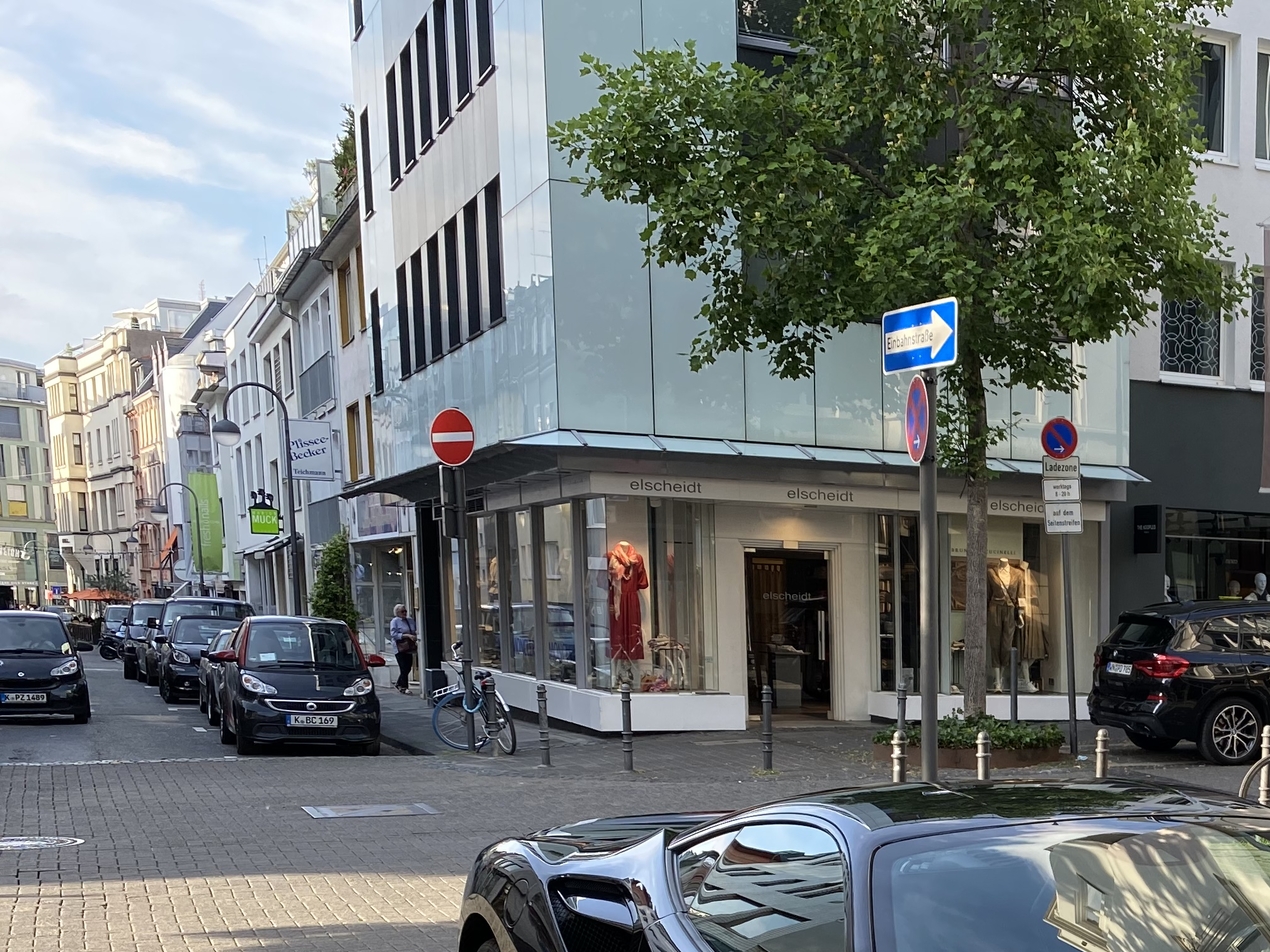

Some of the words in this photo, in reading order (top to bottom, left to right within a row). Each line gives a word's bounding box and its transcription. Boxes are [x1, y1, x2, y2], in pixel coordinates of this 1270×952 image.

[887, 329, 934, 350] Einbahnstraße
[1045, 462, 1078, 472] Ladezone
[630, 478, 702, 494] elscheidt
[786, 487, 854, 503] elscheidt
[252, 515, 278, 525] MUCK
[1047, 519, 1081, 527] Seitenstreifen
[762, 591, 812, 601] elscheidt
[318, 716, 335, 725] 169
